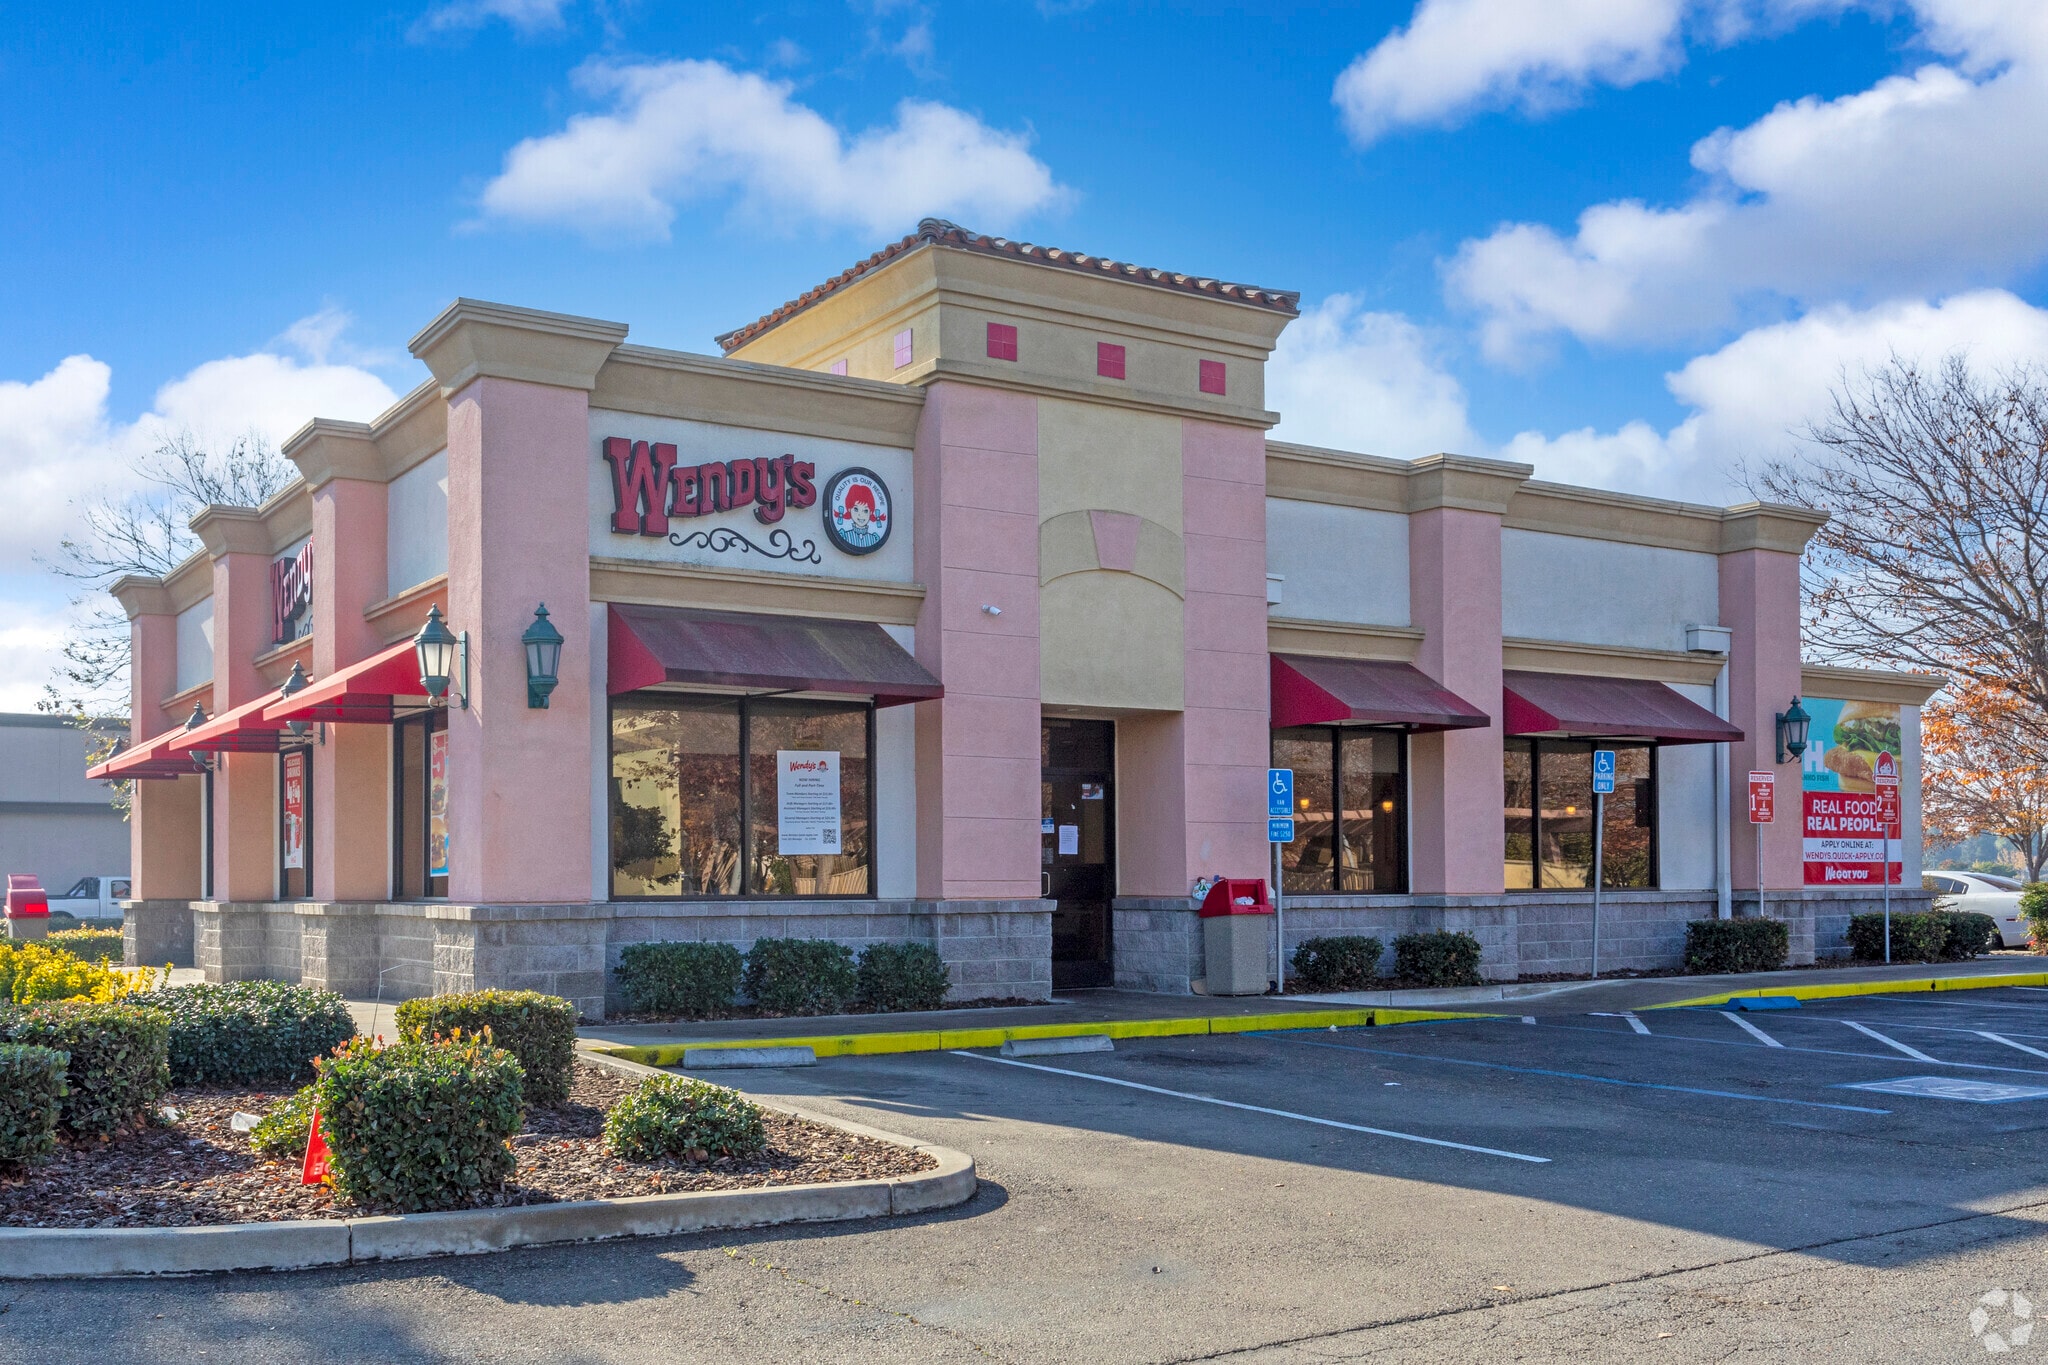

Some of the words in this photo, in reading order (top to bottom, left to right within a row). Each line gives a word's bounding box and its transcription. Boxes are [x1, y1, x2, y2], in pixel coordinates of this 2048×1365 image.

[835, 479, 851, 501] QUALITY
[860, 477, 872, 486] OUR
[872, 485, 885, 506] RECIPE
[790, 760, 816, 772] Wendy's
[1598, 782, 1610, 790] ONLY
[1751, 794, 1757, 811] 1
[1813, 799, 1842, 814] REAL
[1877, 796, 1882, 812] 2
[1807, 816, 1837, 831] REAL
[1864, 841, 1874, 849] AT:
[1805, 851, 1884, 860] WENDYS.QUICK-APPLY.CO
[1836, 870, 1851, 879] GOT
[1852, 870, 1869, 879] YOU
